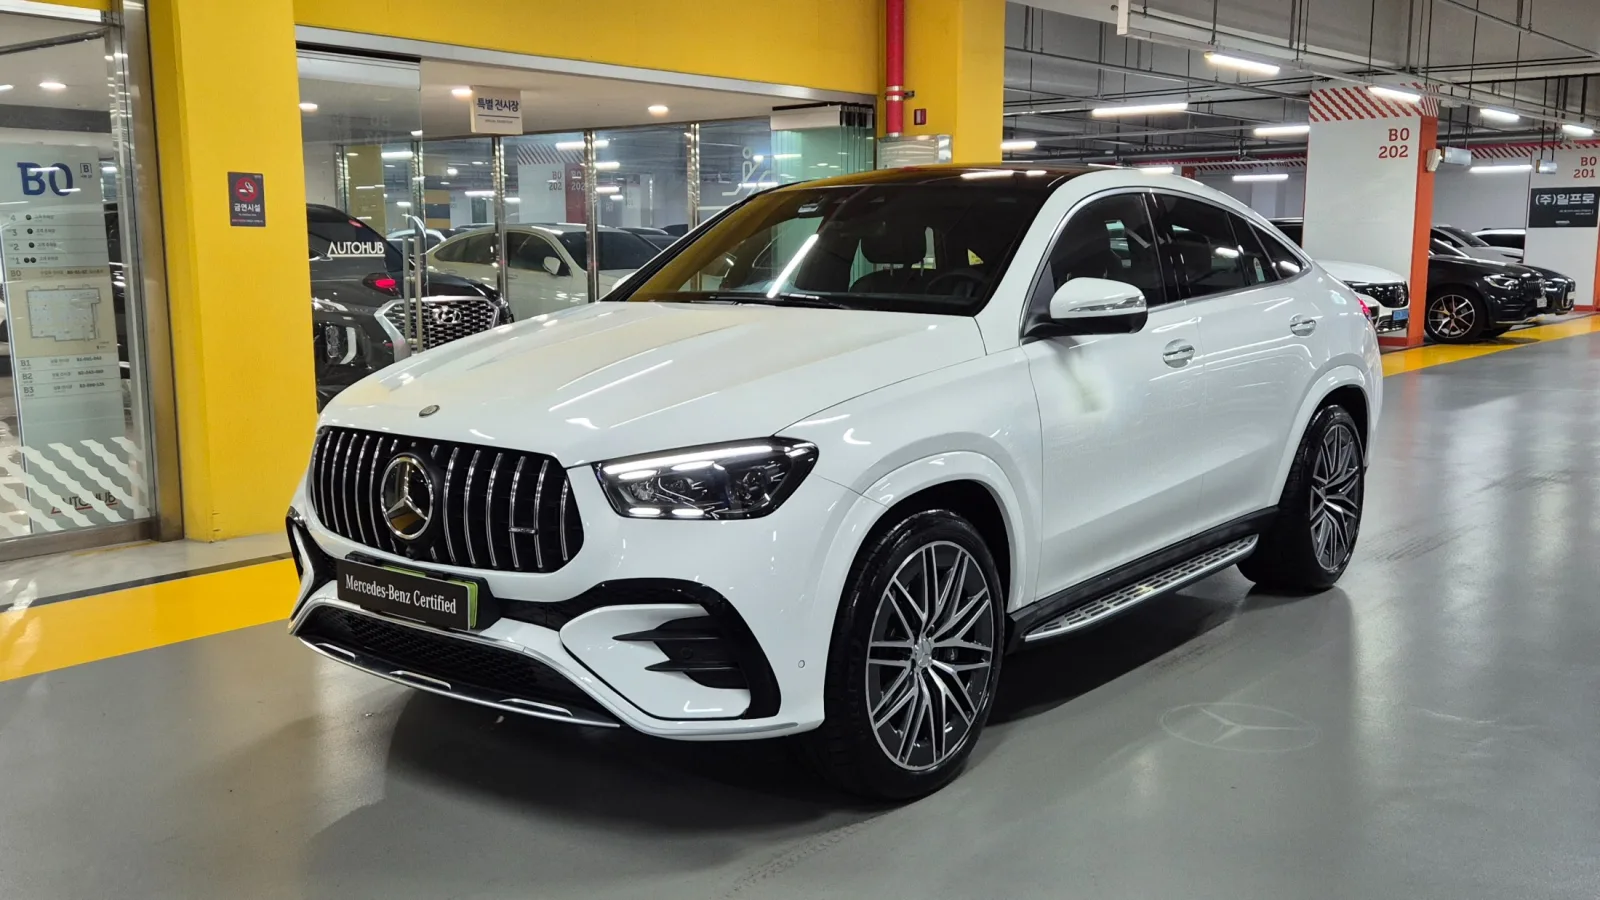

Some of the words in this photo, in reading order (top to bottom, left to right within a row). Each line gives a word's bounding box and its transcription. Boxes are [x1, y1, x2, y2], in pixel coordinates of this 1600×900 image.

[477, 97, 493, 110] 특별
[494, 99, 520, 112] 전시장
[1378, 144, 1409, 159] 202
[1573, 168, 1596, 178] 201
[549, 181, 562, 191] 202
[1535, 193, 1595, 206] (주)일프로
[234, 202, 261, 213] 금연시설
[327, 241, 386, 257] AUTOHUB
[345, 573, 411, 604] Mercedes-Benz
[413, 590, 457, 614] Certified
